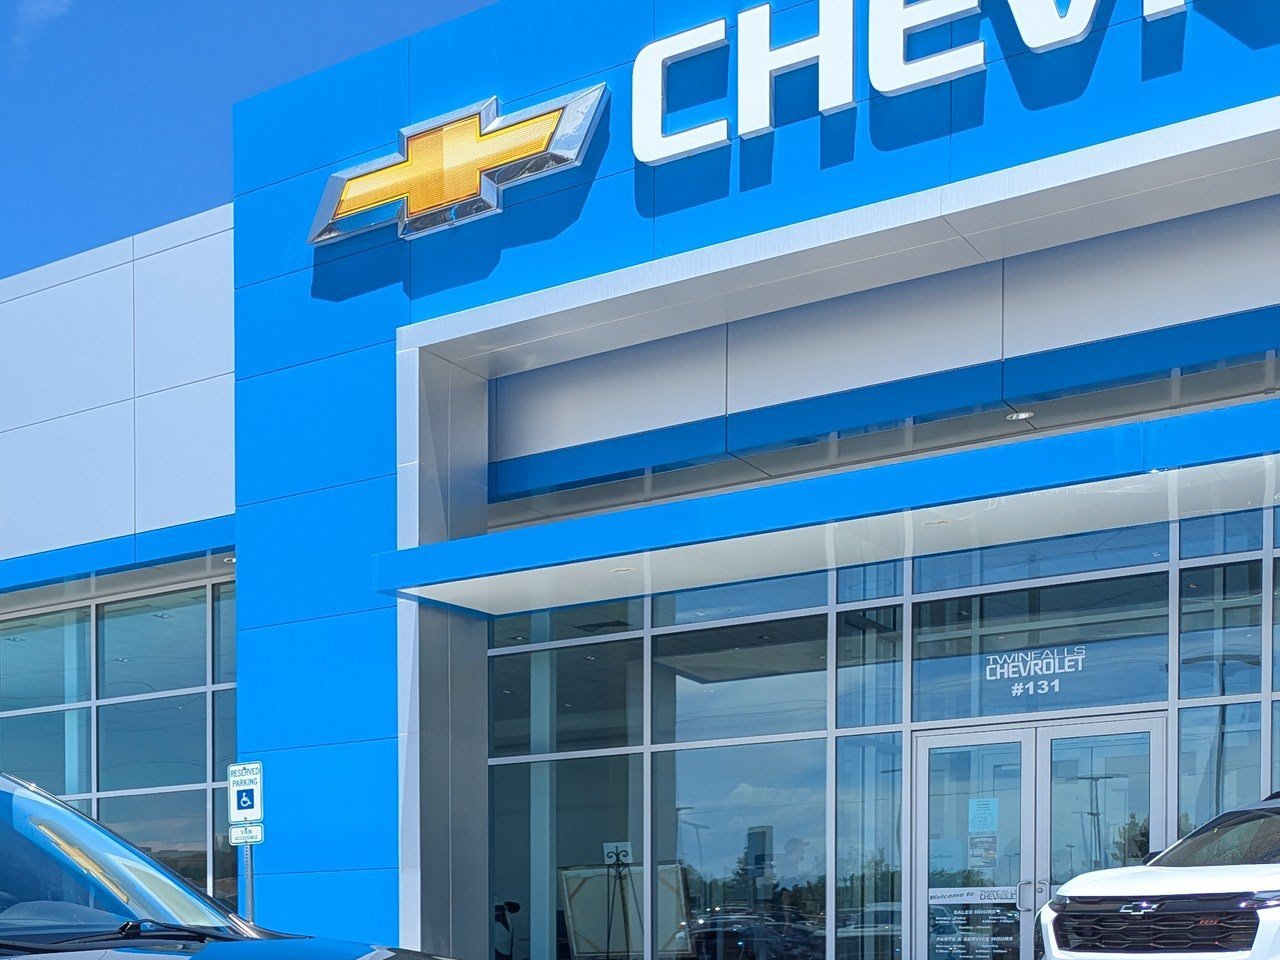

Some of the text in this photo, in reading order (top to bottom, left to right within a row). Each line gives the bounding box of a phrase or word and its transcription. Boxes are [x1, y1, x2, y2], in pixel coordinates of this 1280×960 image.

[985, 655, 1087, 681] CHEVROLET
[1011, 679, 1060, 697] #131
[230, 767, 260, 777] RESERVED
[232, 778, 258, 788] PARKING
